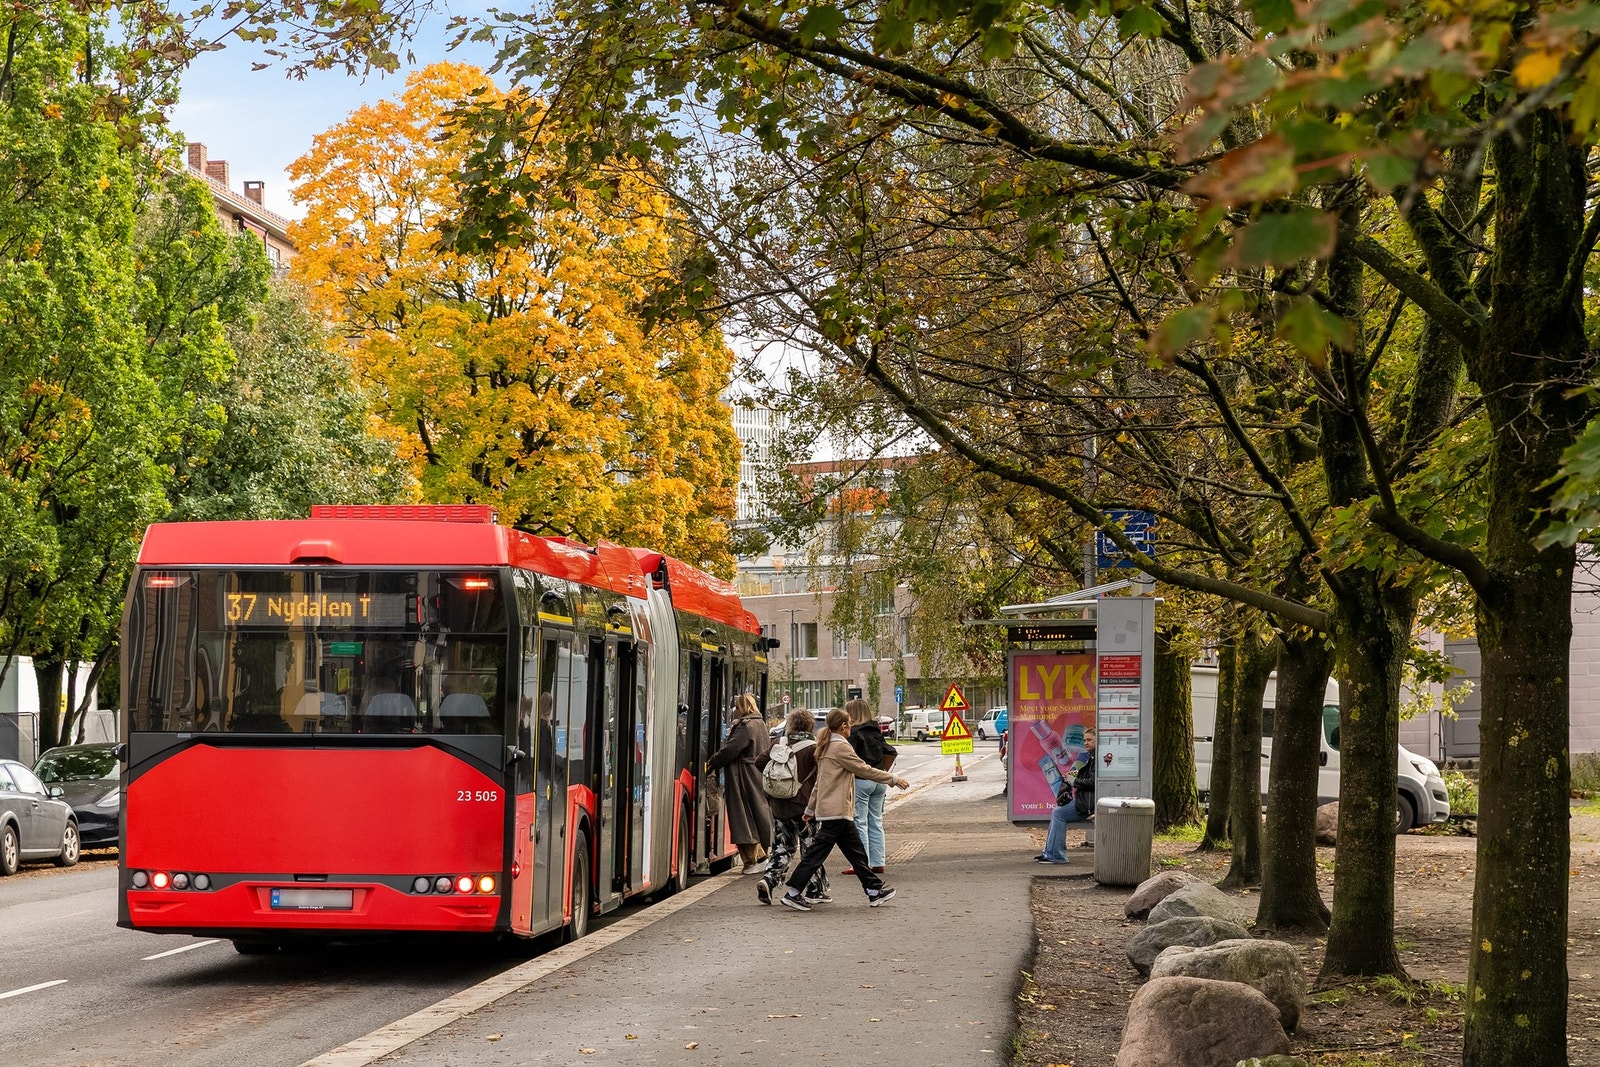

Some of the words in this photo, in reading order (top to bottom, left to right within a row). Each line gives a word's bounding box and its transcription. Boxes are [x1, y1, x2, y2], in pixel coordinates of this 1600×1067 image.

[227, 594, 257, 621] 37
[267, 594, 352, 623] Nydalen
[1020, 664, 1097, 700] LYK
[1020, 704, 1039, 712] Meet
[1040, 705, 1059, 714] your
[457, 790, 472, 802] 23
[475, 790, 498, 802] 505
